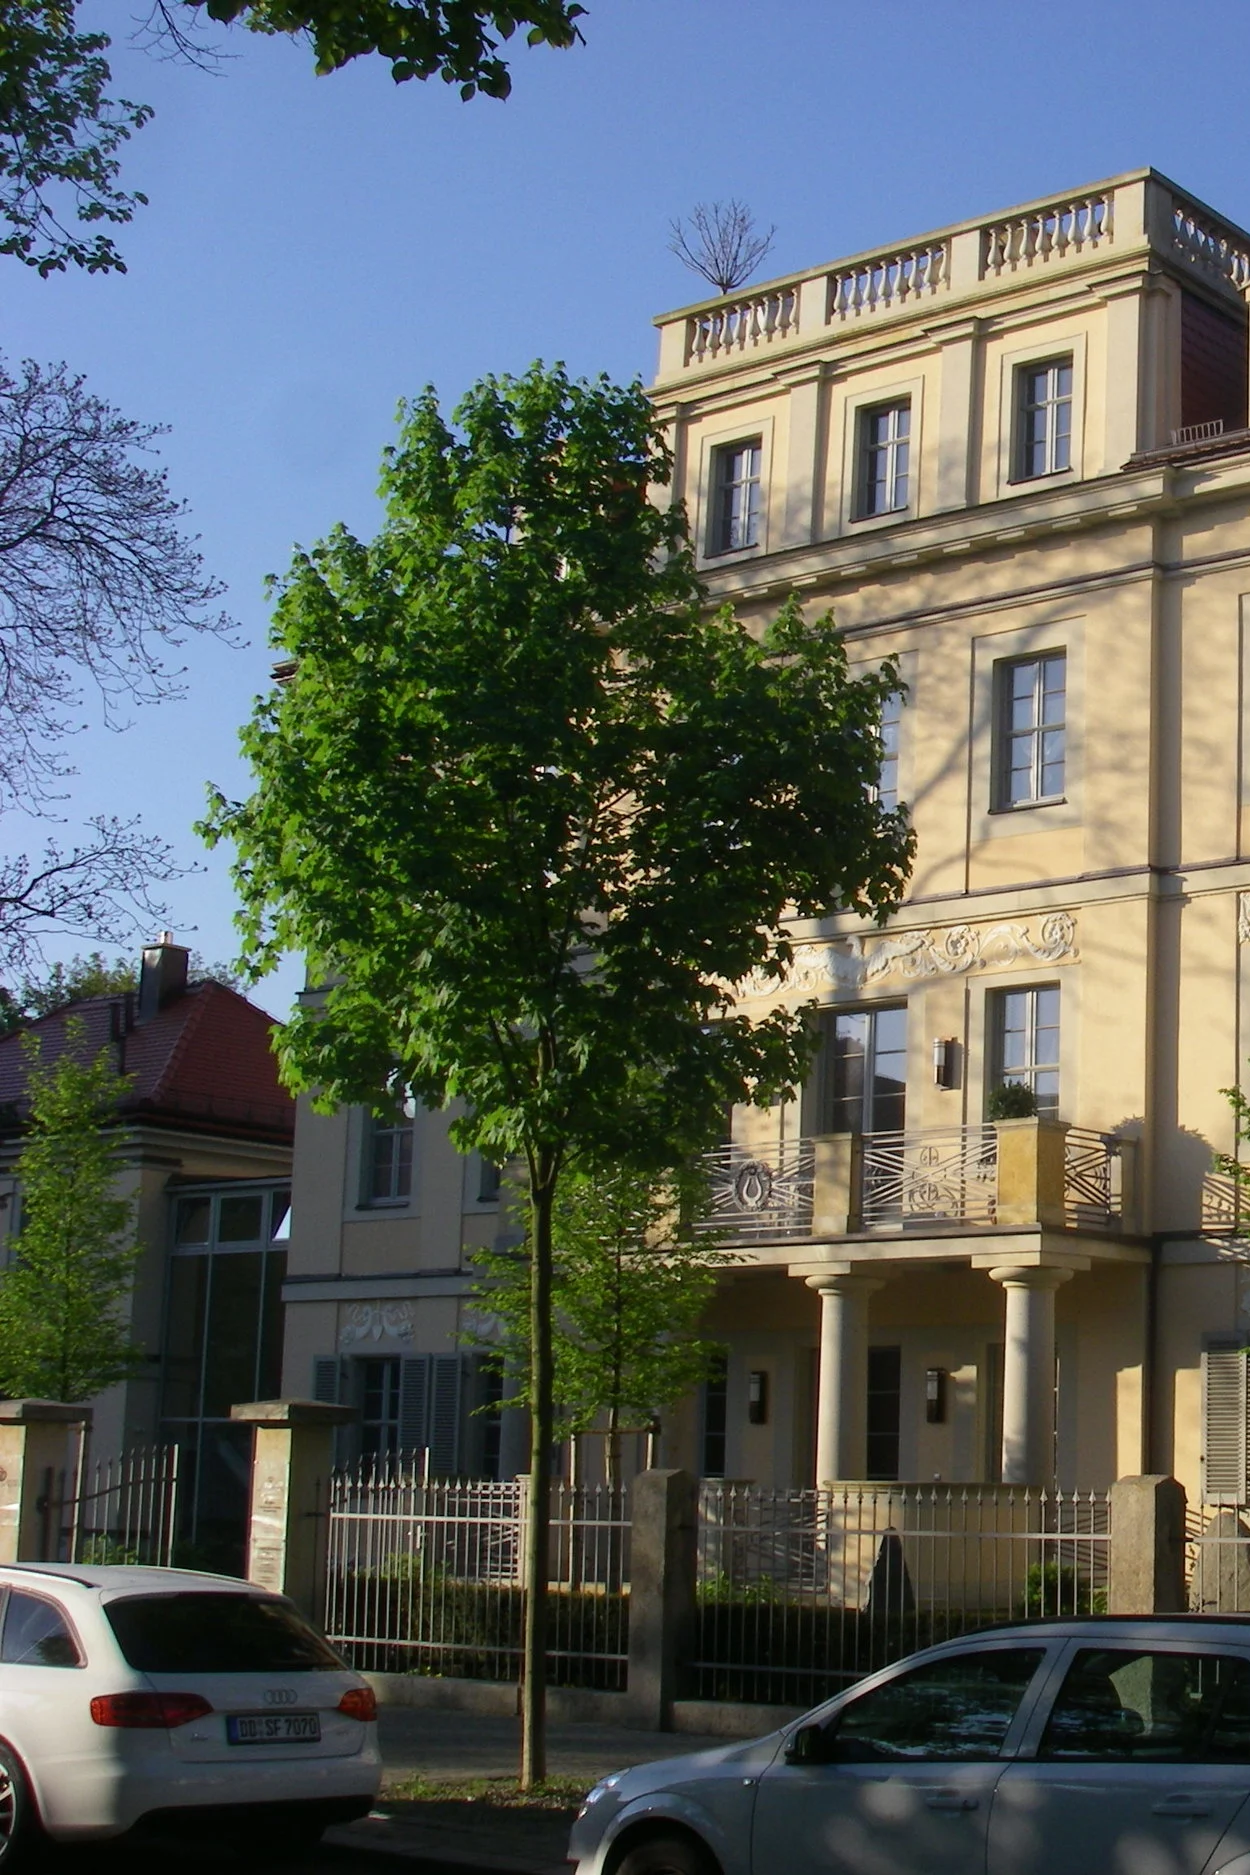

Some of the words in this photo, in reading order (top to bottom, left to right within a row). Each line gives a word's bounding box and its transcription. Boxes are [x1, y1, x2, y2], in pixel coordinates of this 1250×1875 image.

[239, 1719, 257, 1738] DD
[265, 1718, 281, 1737] SF
[284, 1717, 317, 1736] 7070
